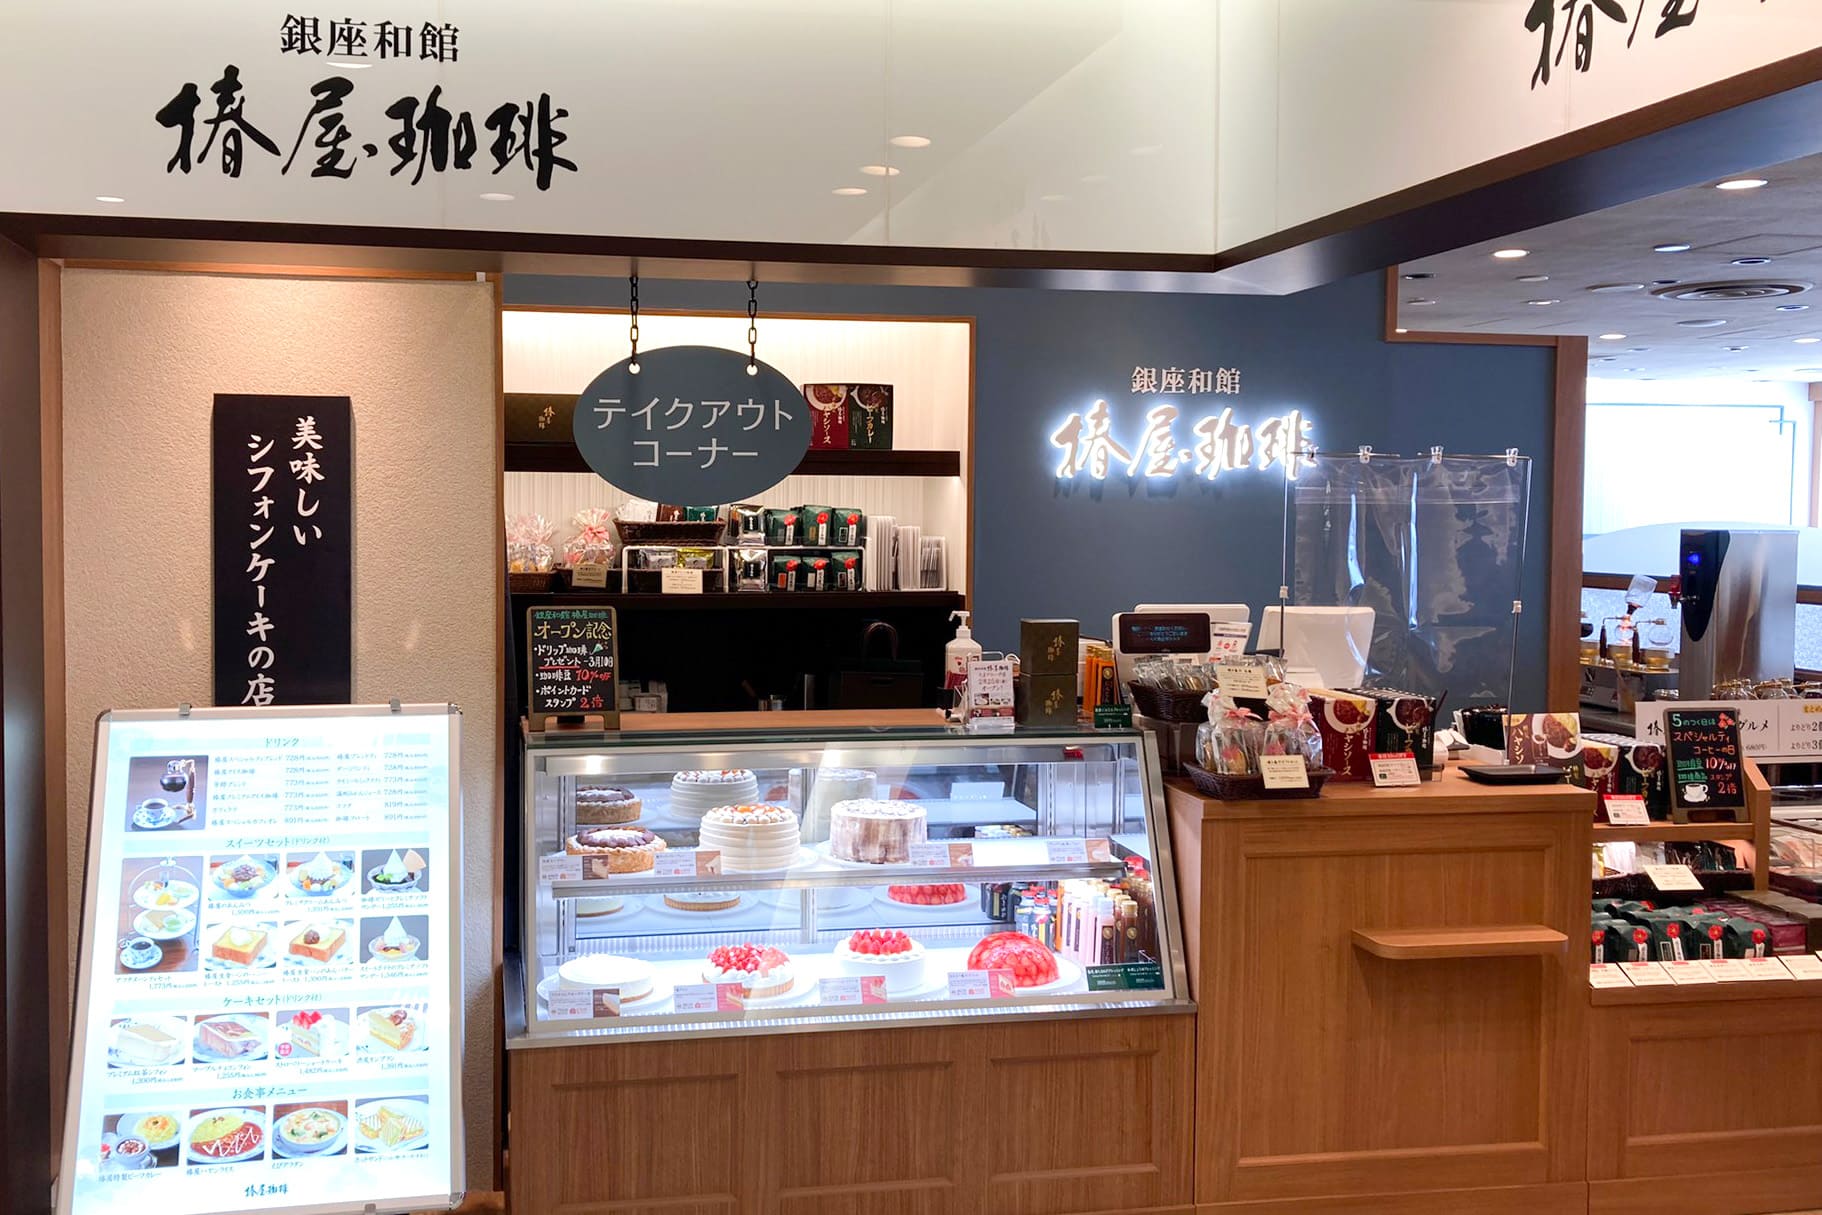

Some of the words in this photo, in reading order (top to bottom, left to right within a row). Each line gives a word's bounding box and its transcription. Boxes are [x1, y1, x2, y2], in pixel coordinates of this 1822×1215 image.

[280, 14, 459, 62] 銀座和館
[156, 65, 578, 191] 椿屋珈琲
[1131, 366, 1241, 395] 銀座和館
[594, 398, 793, 431] テイクアウト
[634, 438, 759, 469] コーナー
[1050, 399, 1318, 481] 椿屋珈琲
[289, 416, 325, 546] 美味しい
[241, 434, 275, 707] シフォンケーキの店
[534, 621, 612, 640] オープン記念
[543, 656, 581, 666] プレゼント
[544, 697, 577, 708] スタンプ
[264, 737, 299, 748] ドリンク
[1673, 731, 1730, 742] スペシャルティ
[1717, 782, 1737, 795] 2倍
[233, 1087, 308, 1100] お食事メニュー
